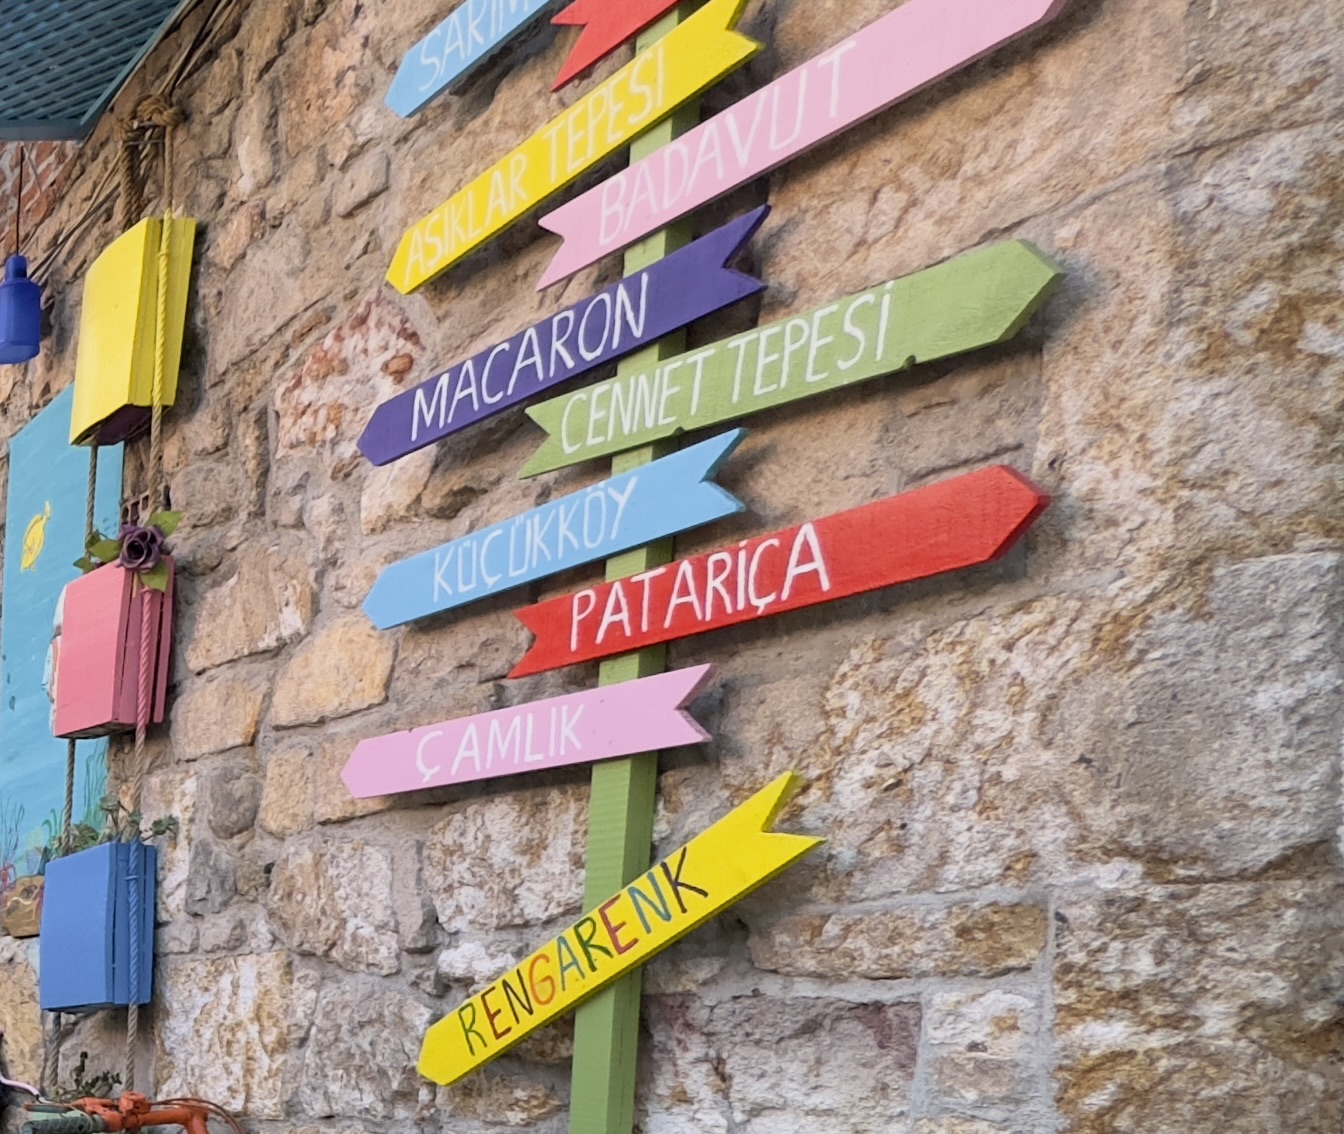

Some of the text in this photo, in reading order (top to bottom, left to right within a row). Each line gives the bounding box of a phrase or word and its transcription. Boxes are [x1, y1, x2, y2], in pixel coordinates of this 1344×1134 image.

[598, 41, 856, 246] BADAVUT
[412, 272, 648, 441] MACARON
[561, 281, 895, 455] CENNET TEPESİ
[432, 475, 638, 602] KÜÇÜKKÖY
[570, 523, 830, 651] PATARİÇA
[415, 704, 585, 783] ÇAMLIK
[458, 846, 708, 1056] RENGARENK
